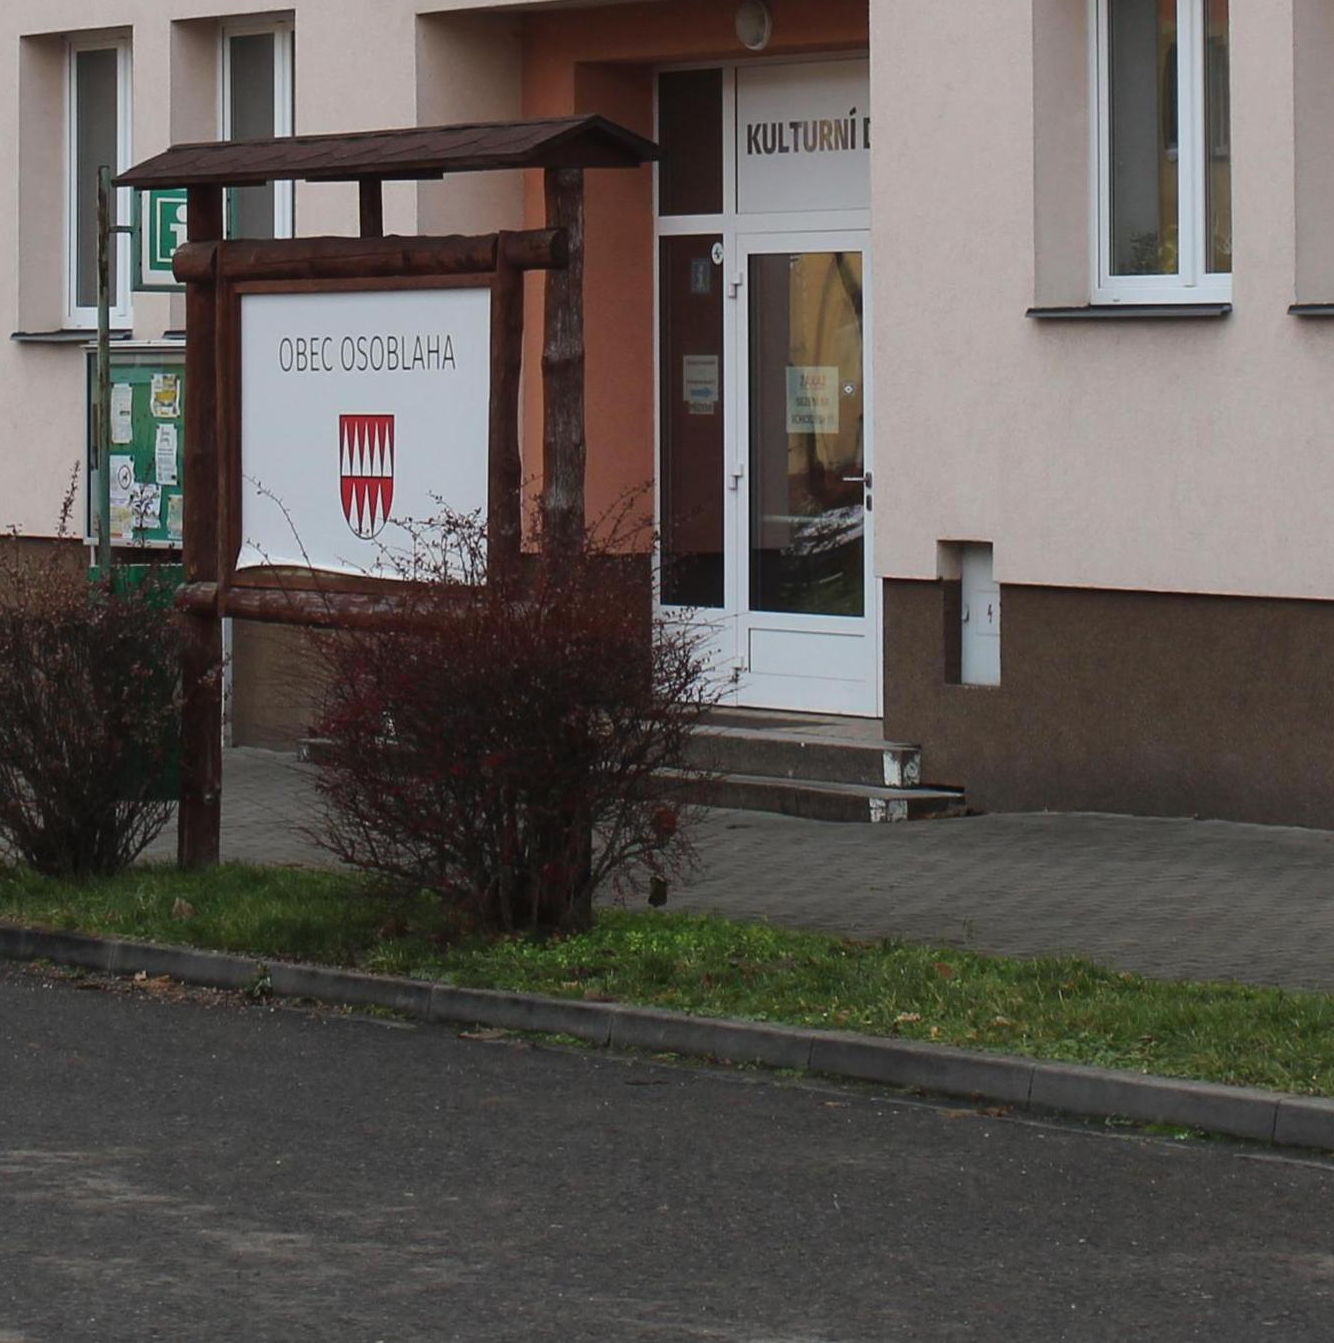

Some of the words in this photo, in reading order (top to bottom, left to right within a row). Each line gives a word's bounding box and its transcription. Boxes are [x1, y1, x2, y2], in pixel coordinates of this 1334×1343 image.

[747, 107, 857, 155] KULTURNÍ
[279, 336, 334, 372] OBEC
[340, 334, 457, 372] OSOBLAHA
